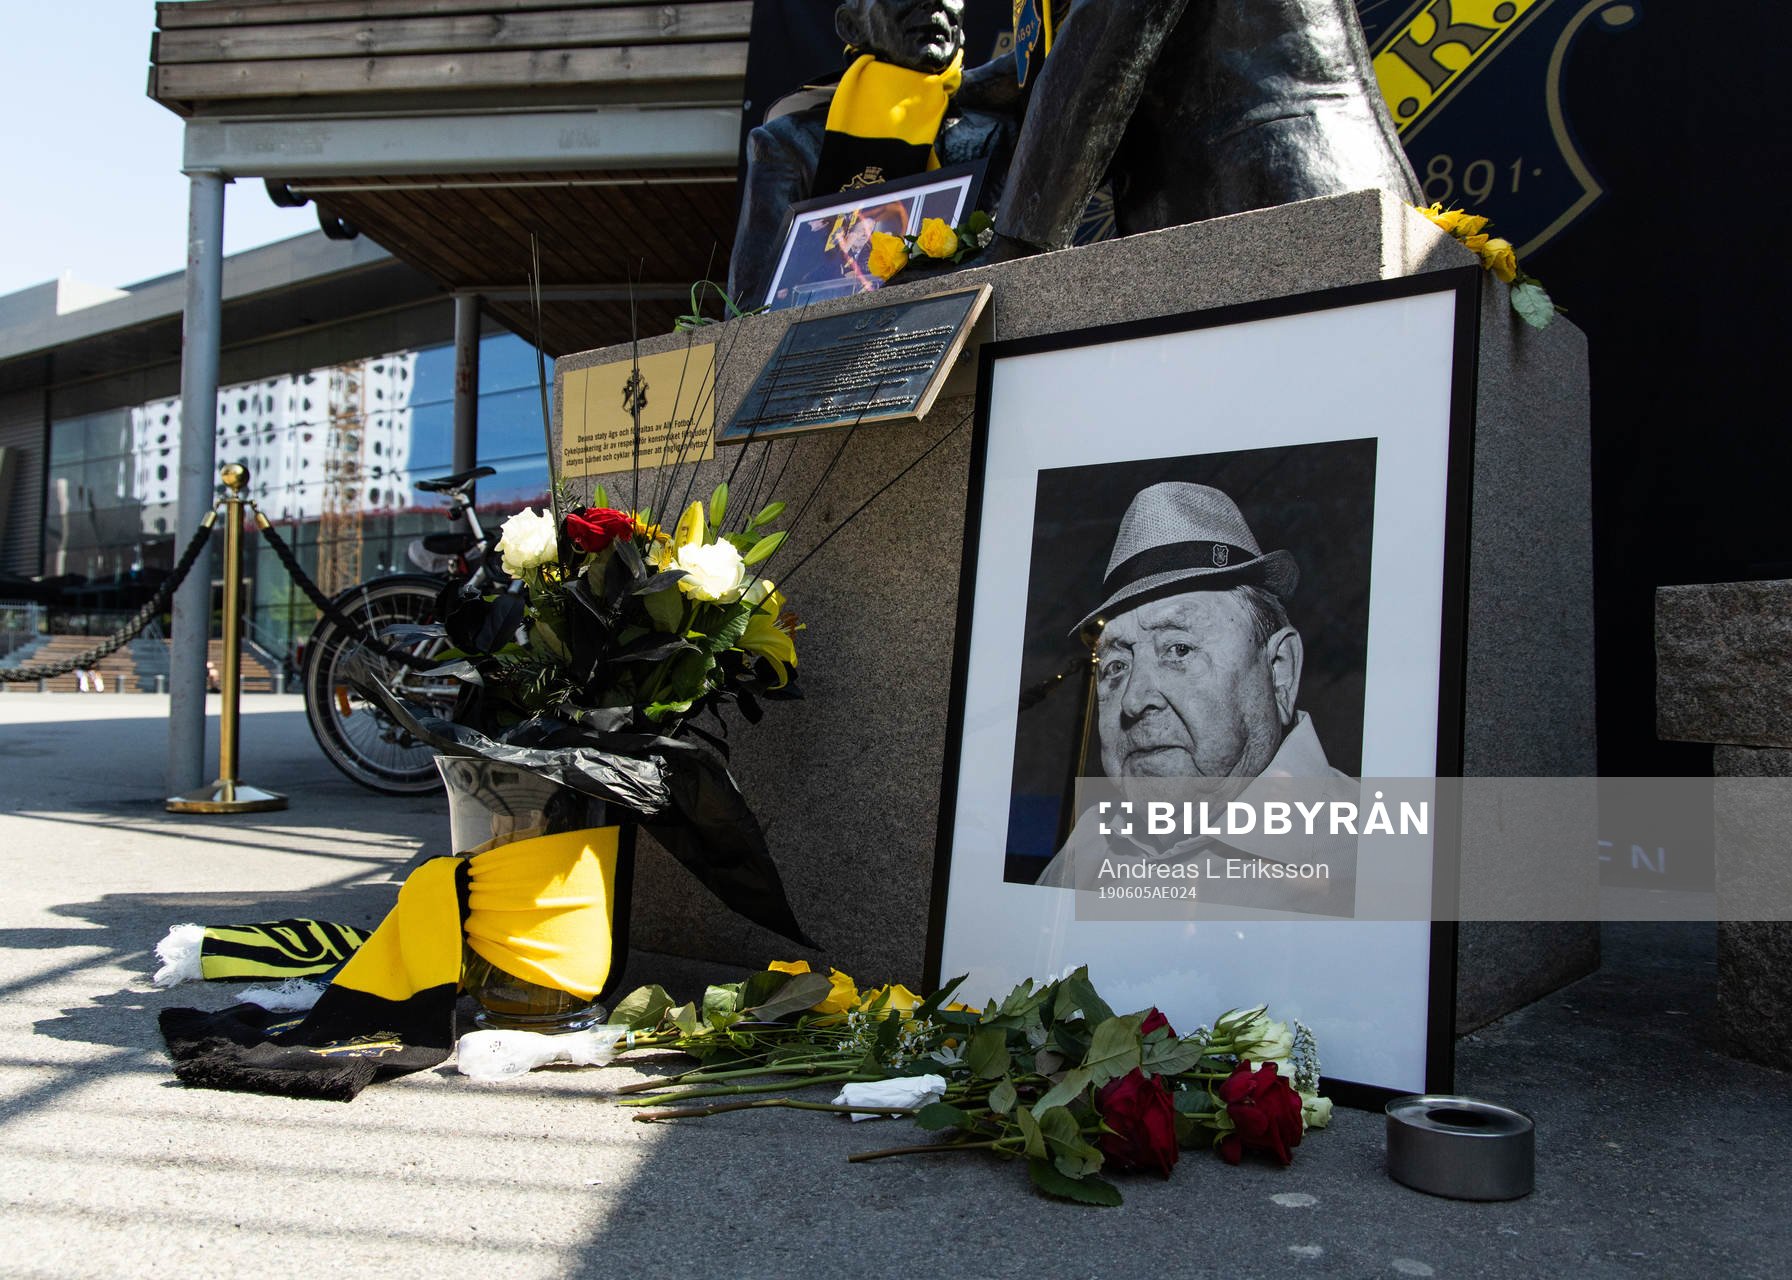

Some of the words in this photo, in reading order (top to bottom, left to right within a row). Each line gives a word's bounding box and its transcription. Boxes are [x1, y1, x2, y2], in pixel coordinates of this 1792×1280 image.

[608, 430, 618, 439] ägs
[619, 427, 630, 436] och
[603, 453, 613, 461] och
[614, 451, 630, 460] cyklar
[654, 446, 662, 454] att
